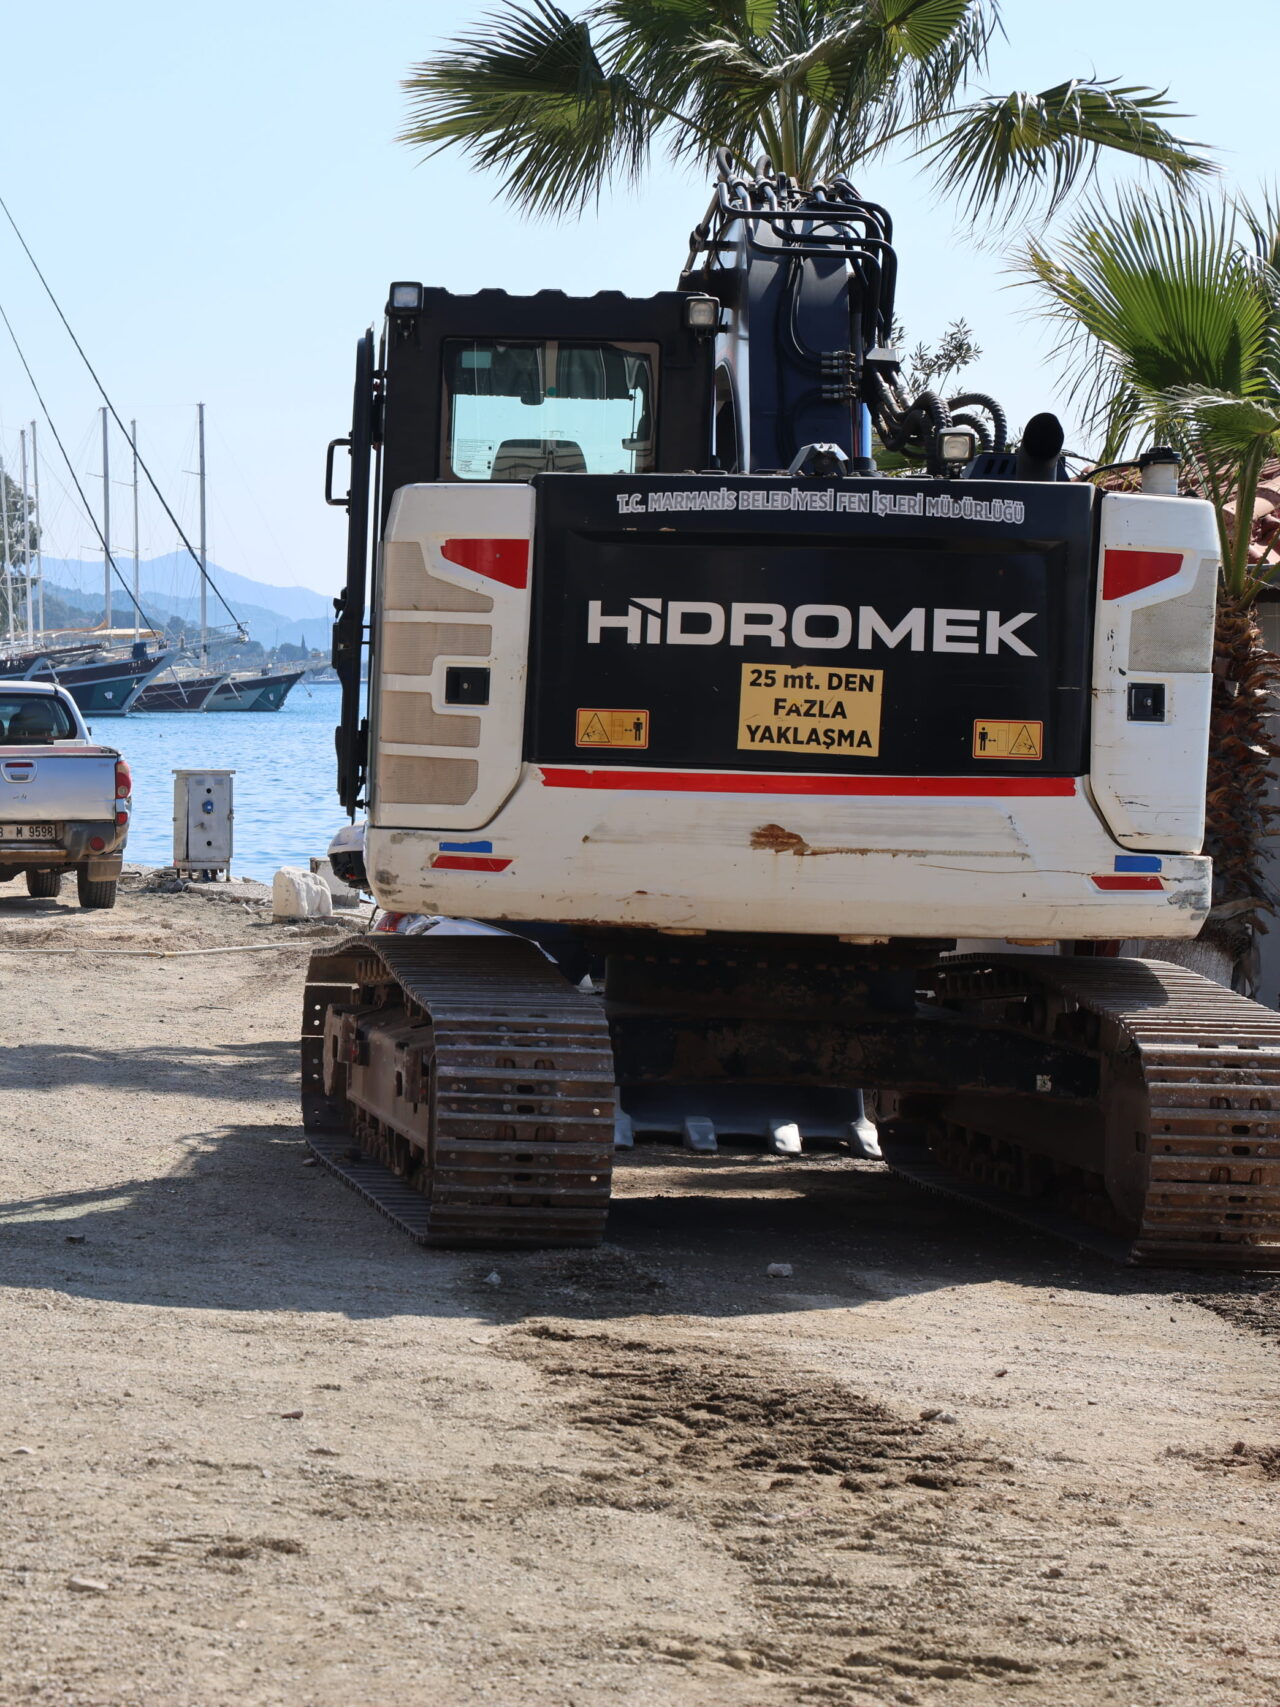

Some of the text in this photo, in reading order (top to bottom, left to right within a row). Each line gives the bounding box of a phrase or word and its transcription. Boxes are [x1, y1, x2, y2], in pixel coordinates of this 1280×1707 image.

[617, 487, 1025, 524] T.C. MARMARİS BELEDİYESİ FEN İŞLERİ MÜDÜRLÜĞÜ
[749, 669, 875, 692] 25 mt. DEN
[773, 698, 848, 719] FAZLA
[746, 724, 873, 750] YAKLAŞMA
[28, 826, 53, 837] 9598
